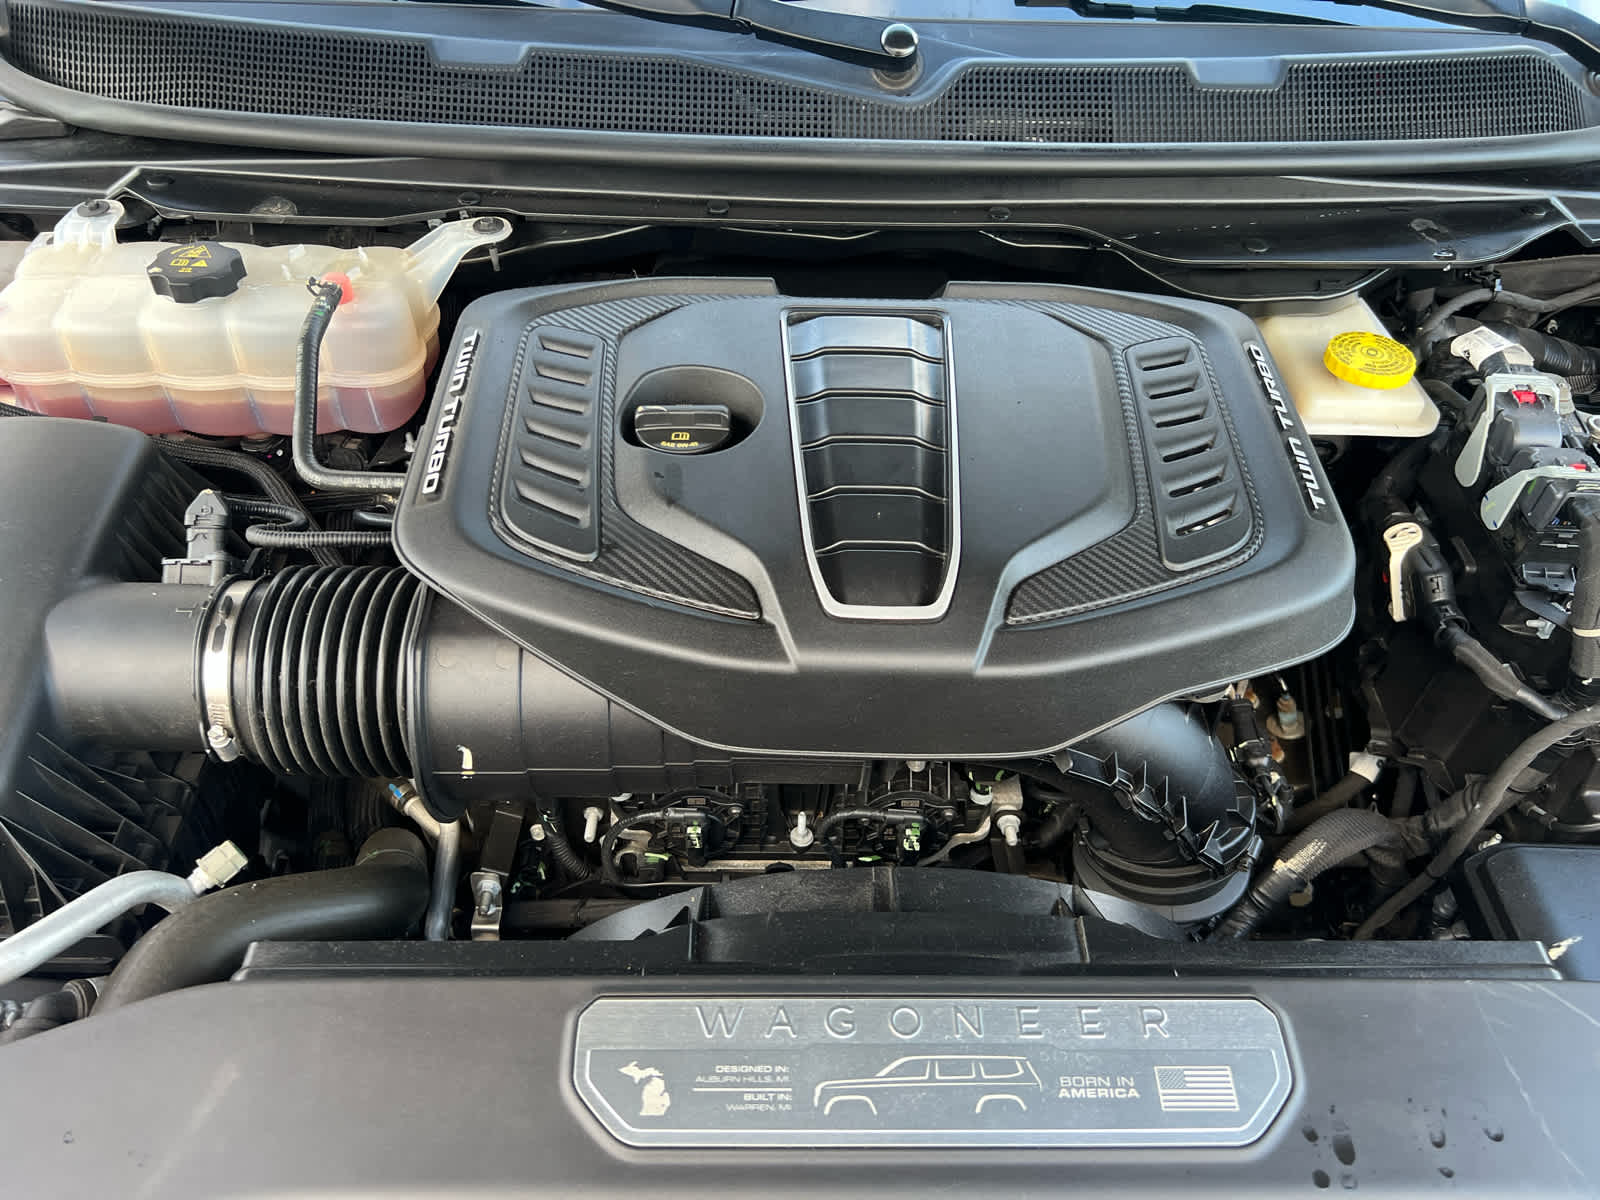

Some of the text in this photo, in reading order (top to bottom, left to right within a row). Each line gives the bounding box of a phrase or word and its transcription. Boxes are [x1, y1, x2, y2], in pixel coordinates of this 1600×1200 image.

[422, 330, 479, 494] TWIN TURBO
[1249, 344, 1326, 510] TWIN TURBO
[695, 1005, 1169, 1038] WAGONEER
[715, 1065, 790, 1073] DESIGNED IN:
[695, 1075, 741, 1083] AUBURN
[1059, 1076, 1135, 1087] BORN IN
[743, 1093, 776, 1101] BUILT
[1058, 1088, 1140, 1098] AMERICA
